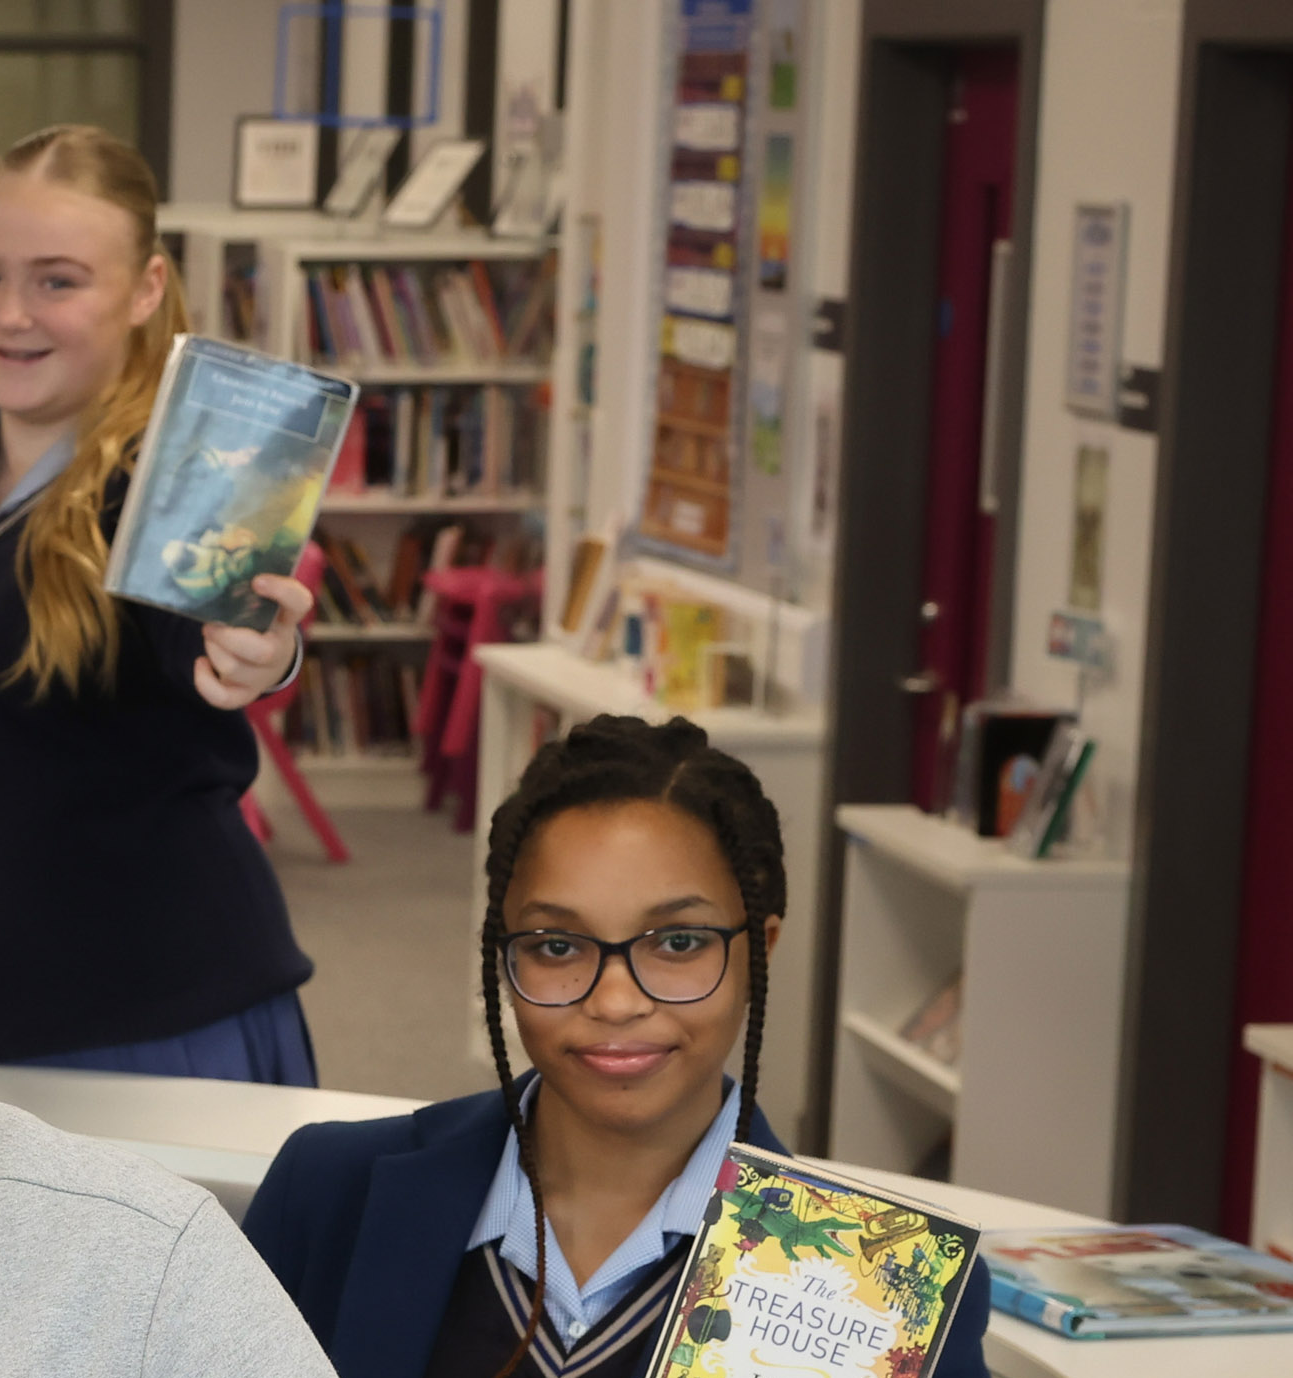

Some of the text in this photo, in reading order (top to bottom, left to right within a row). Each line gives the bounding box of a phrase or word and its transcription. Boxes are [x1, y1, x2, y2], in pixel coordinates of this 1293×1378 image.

[802, 1274, 838, 1301] The
[734, 1279, 888, 1351] TREASURE
[749, 1315, 850, 1367] HOUSE
